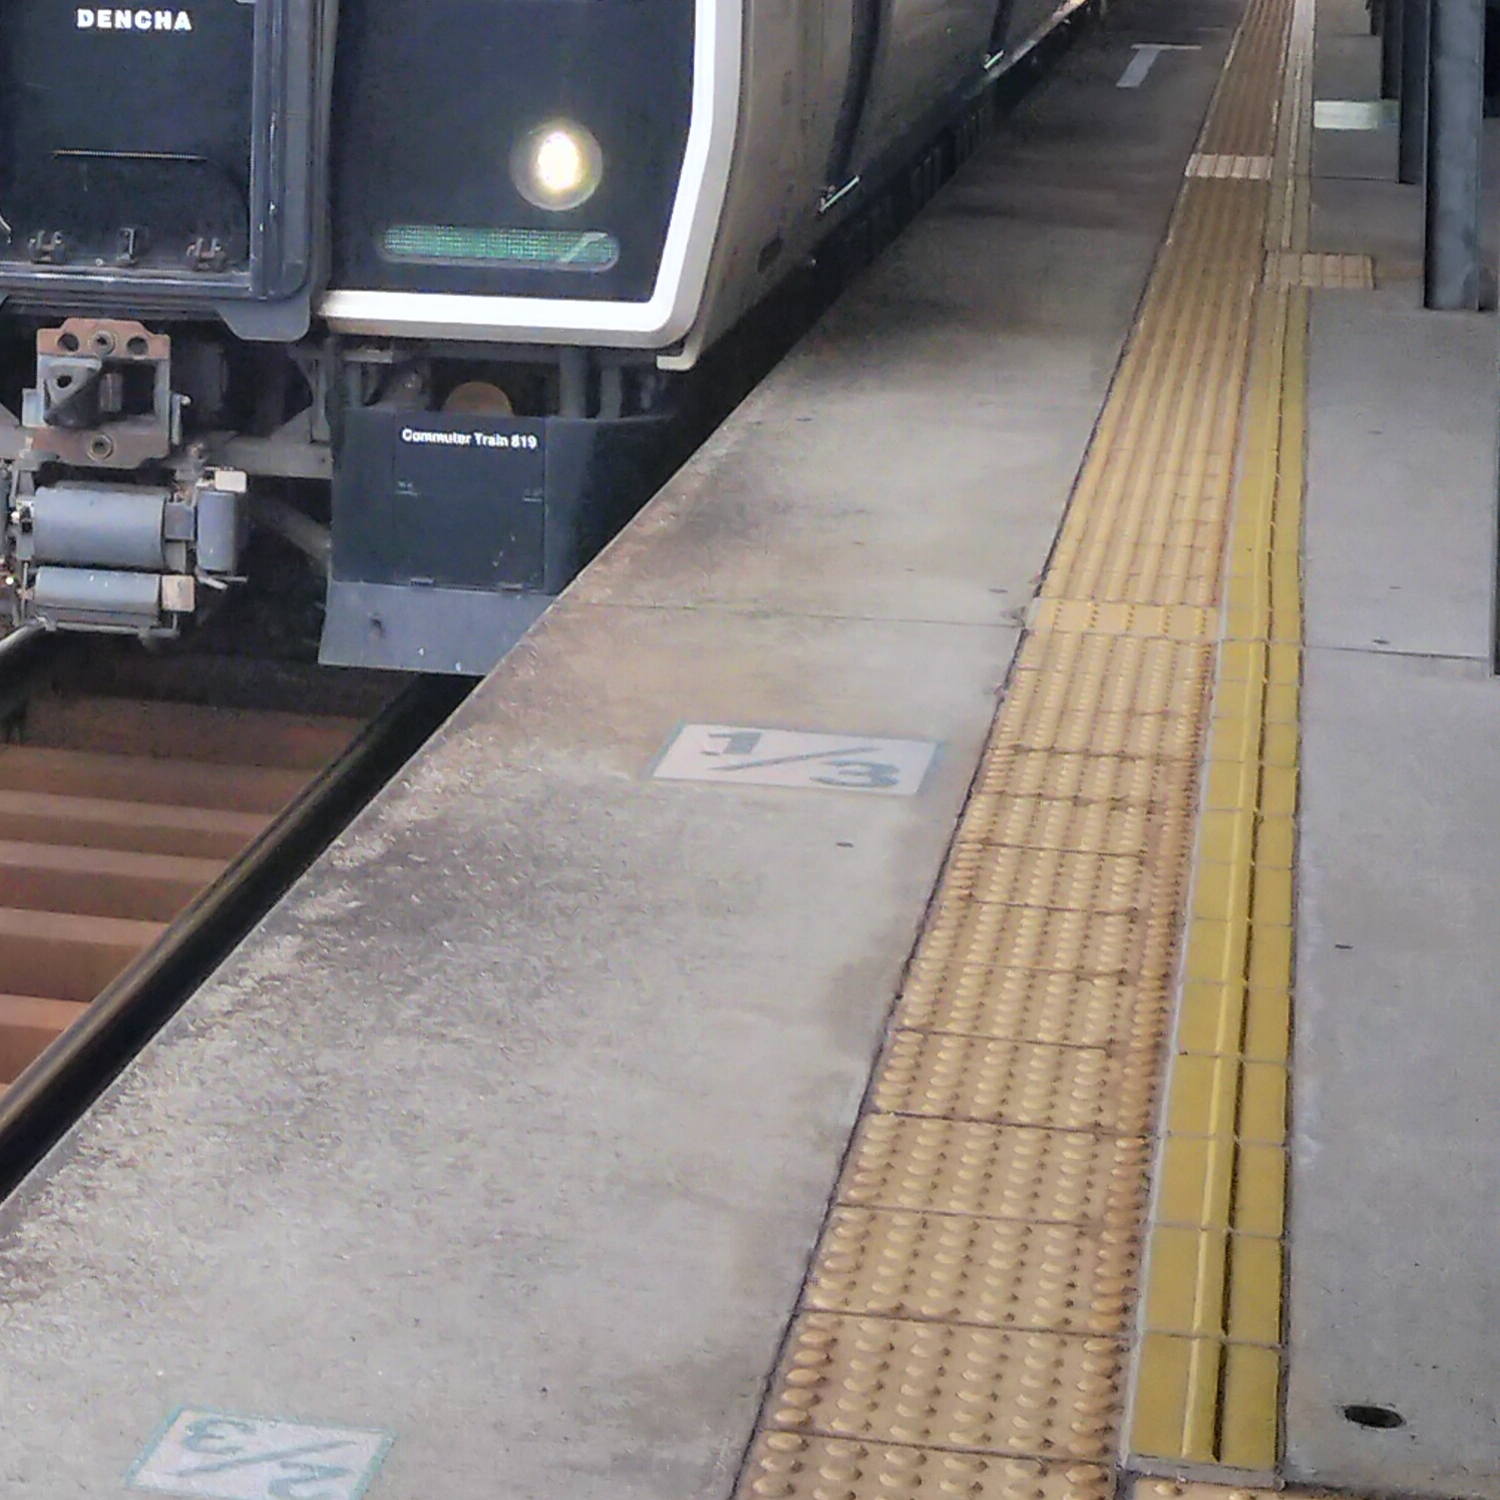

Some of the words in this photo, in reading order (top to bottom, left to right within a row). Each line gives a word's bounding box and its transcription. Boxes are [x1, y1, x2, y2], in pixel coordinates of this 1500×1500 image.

[77, 8, 192, 31] DENCHA
[401, 428, 472, 445] Commuter
[473, 432, 509, 447] Train
[511, 434, 537, 449] 819
